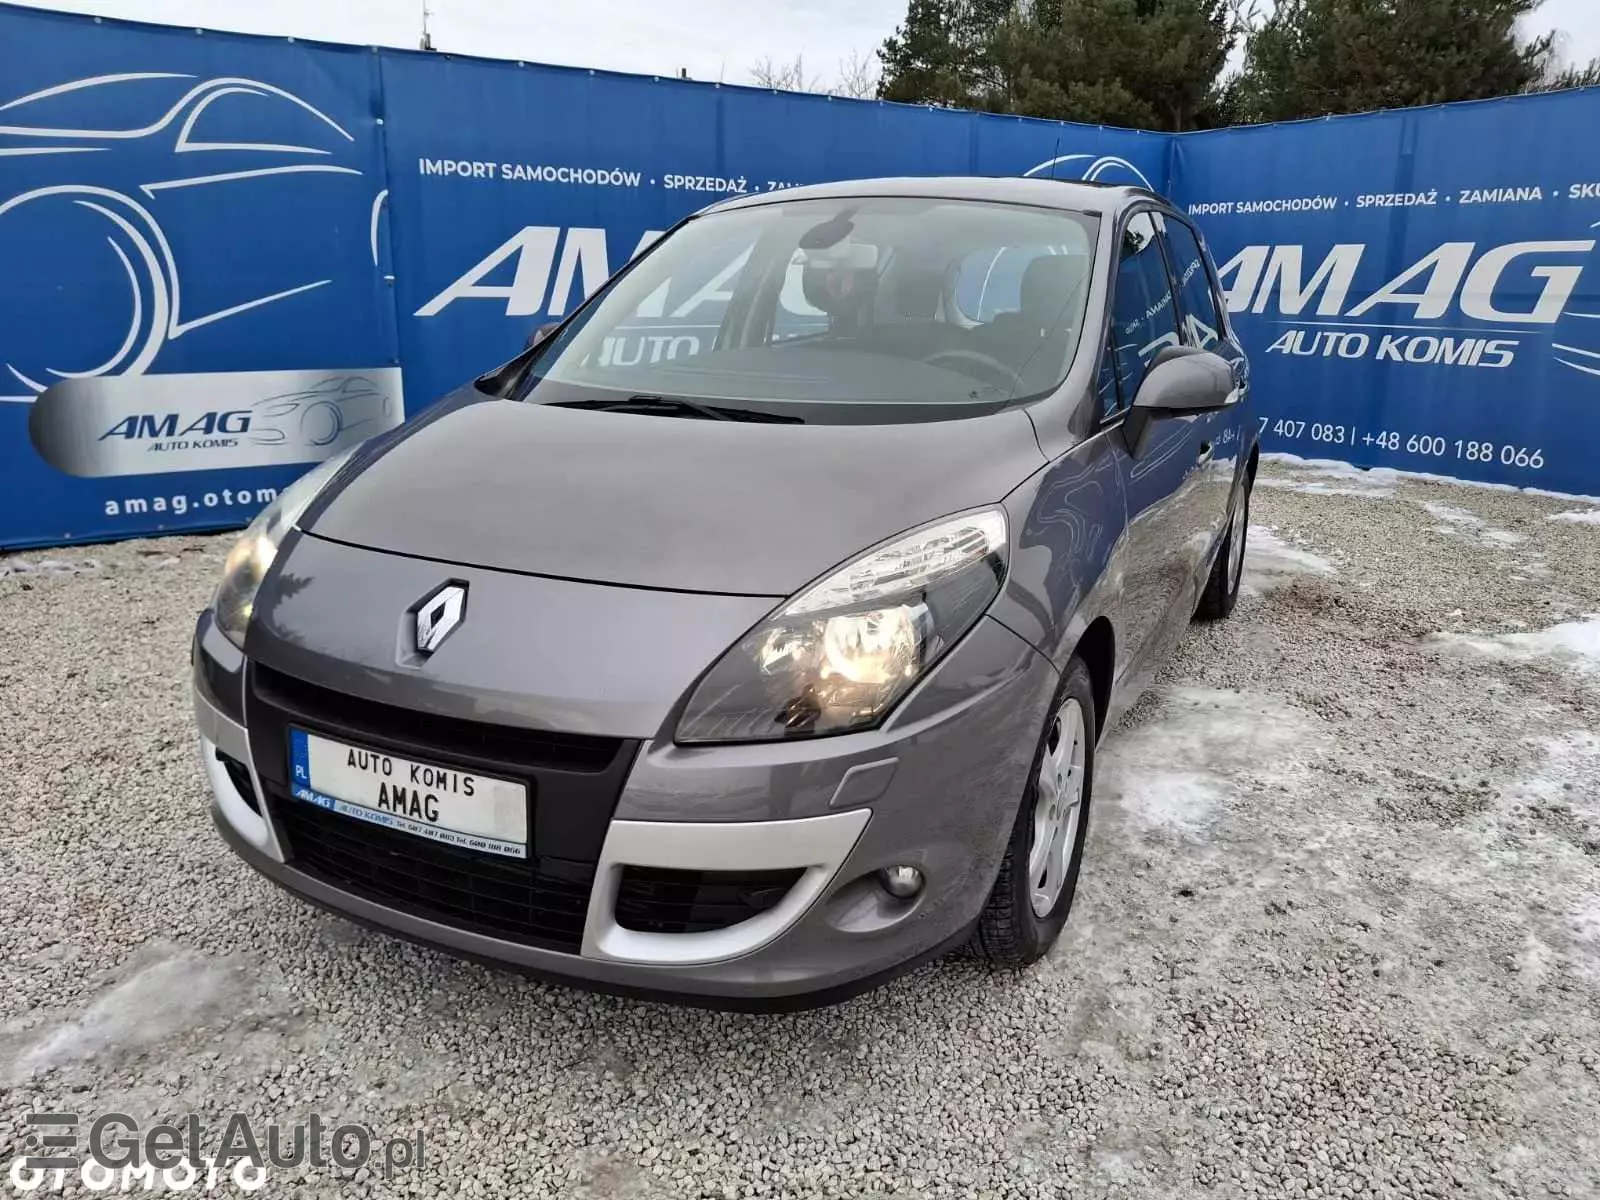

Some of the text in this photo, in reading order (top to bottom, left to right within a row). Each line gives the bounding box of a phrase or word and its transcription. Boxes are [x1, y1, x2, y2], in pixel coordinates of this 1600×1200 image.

[419, 158, 497, 178] IMPORT
[502, 163, 642, 187] SAMOCHODÓW
[664, 174, 748, 193] SPRZEDAŻ
[1188, 201, 1234, 215] IMPORT
[1235, 195, 1337, 214] SAMOCHODÓW
[1356, 188, 1438, 208] SPRZEDAŻ
[1459, 186, 1543, 204] ZAMIANA
[1265, 329, 1519, 368] AUTO KOMIS
[147, 438, 239, 451] AUTO KOMIS
[1273, 419, 1306, 438] 407
[1311, 423, 1345, 443] 083
[1362, 430, 1400, 450] +48
[1406, 434, 1446, 456] 600
[1455, 440, 1493, 462] 188
[1500, 445, 1545, 469] 066
[295, 764, 308, 779] PL
[347, 749, 475, 796] AUTO KOMIS
[378, 782, 440, 822] AMAG
